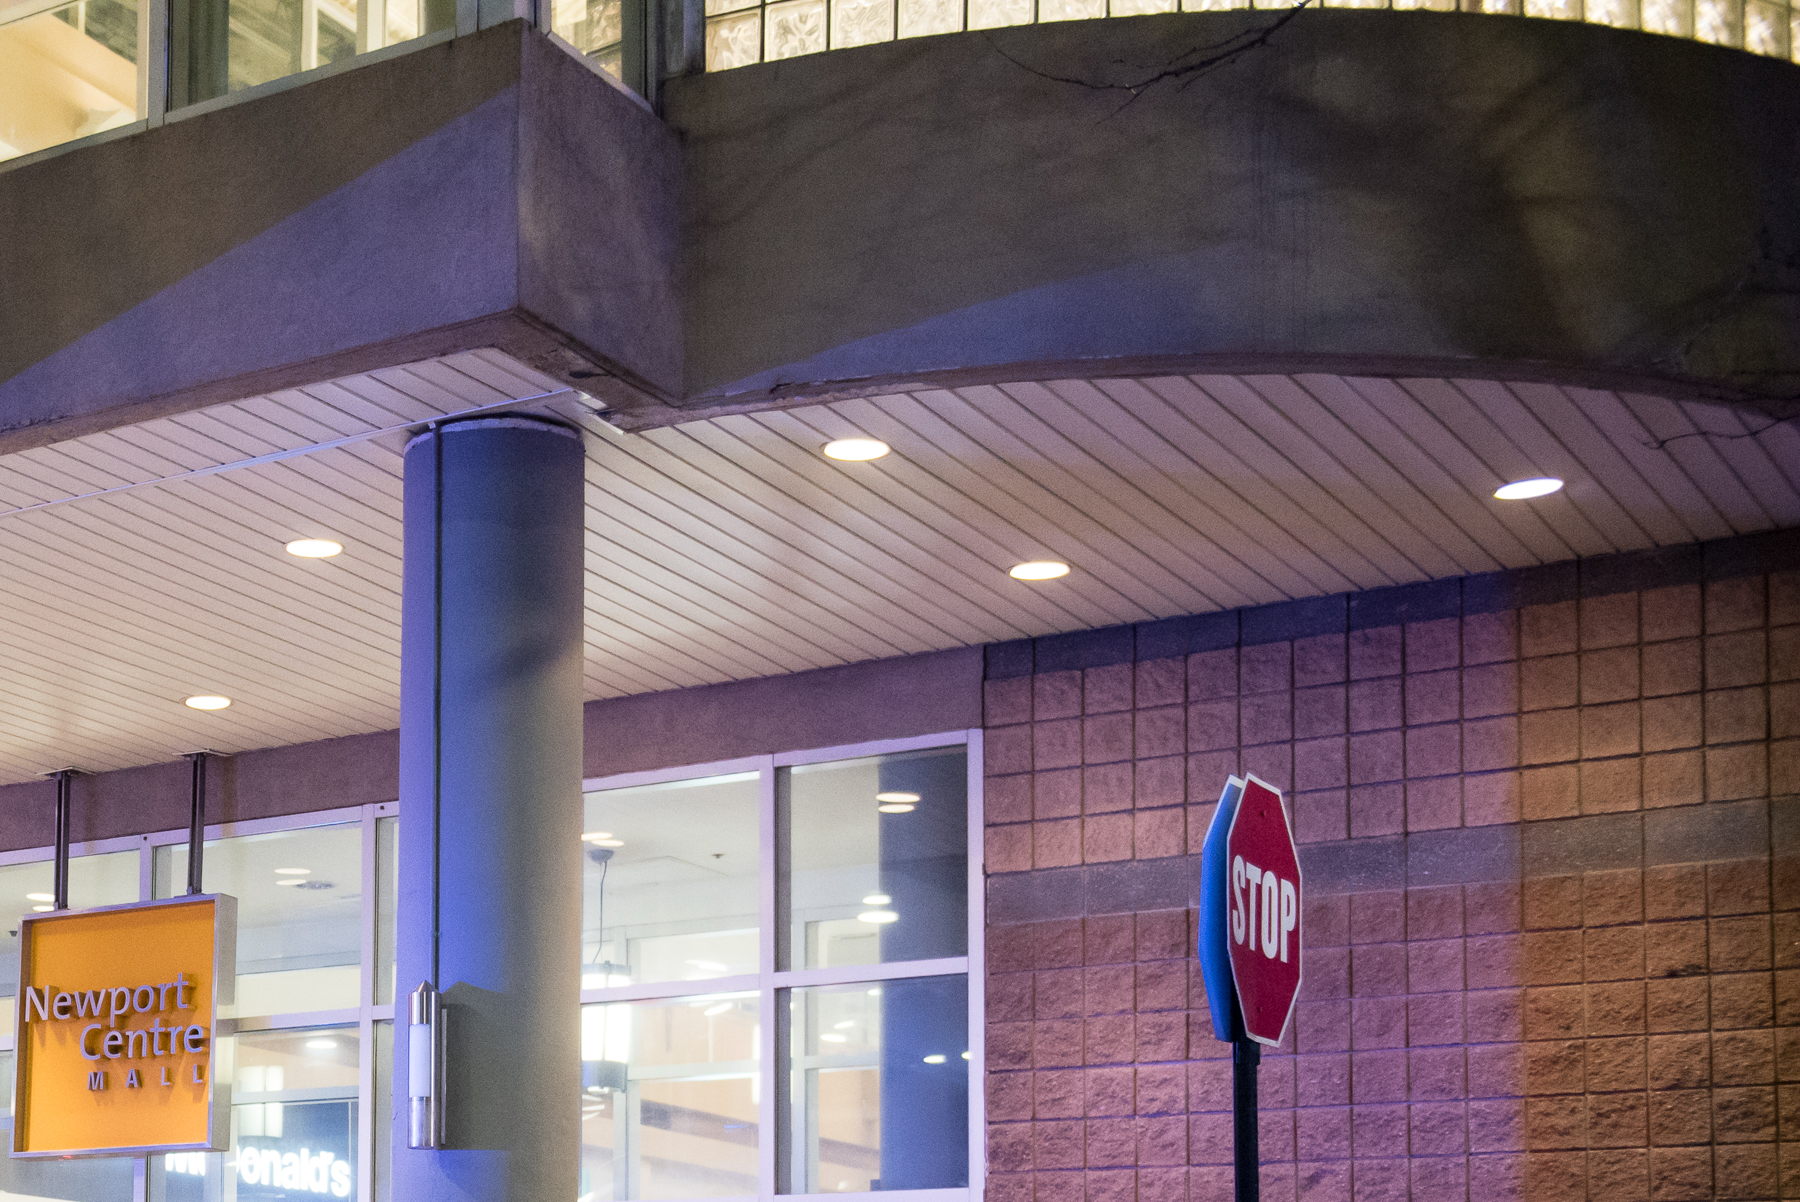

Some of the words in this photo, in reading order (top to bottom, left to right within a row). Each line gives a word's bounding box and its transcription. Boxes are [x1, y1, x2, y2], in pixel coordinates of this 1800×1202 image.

[1232, 854, 1296, 963] STOP
[25, 972, 189, 1026] Newport
[79, 1018, 204, 1061] Centre
[87, 1064, 203, 1091] MALL
